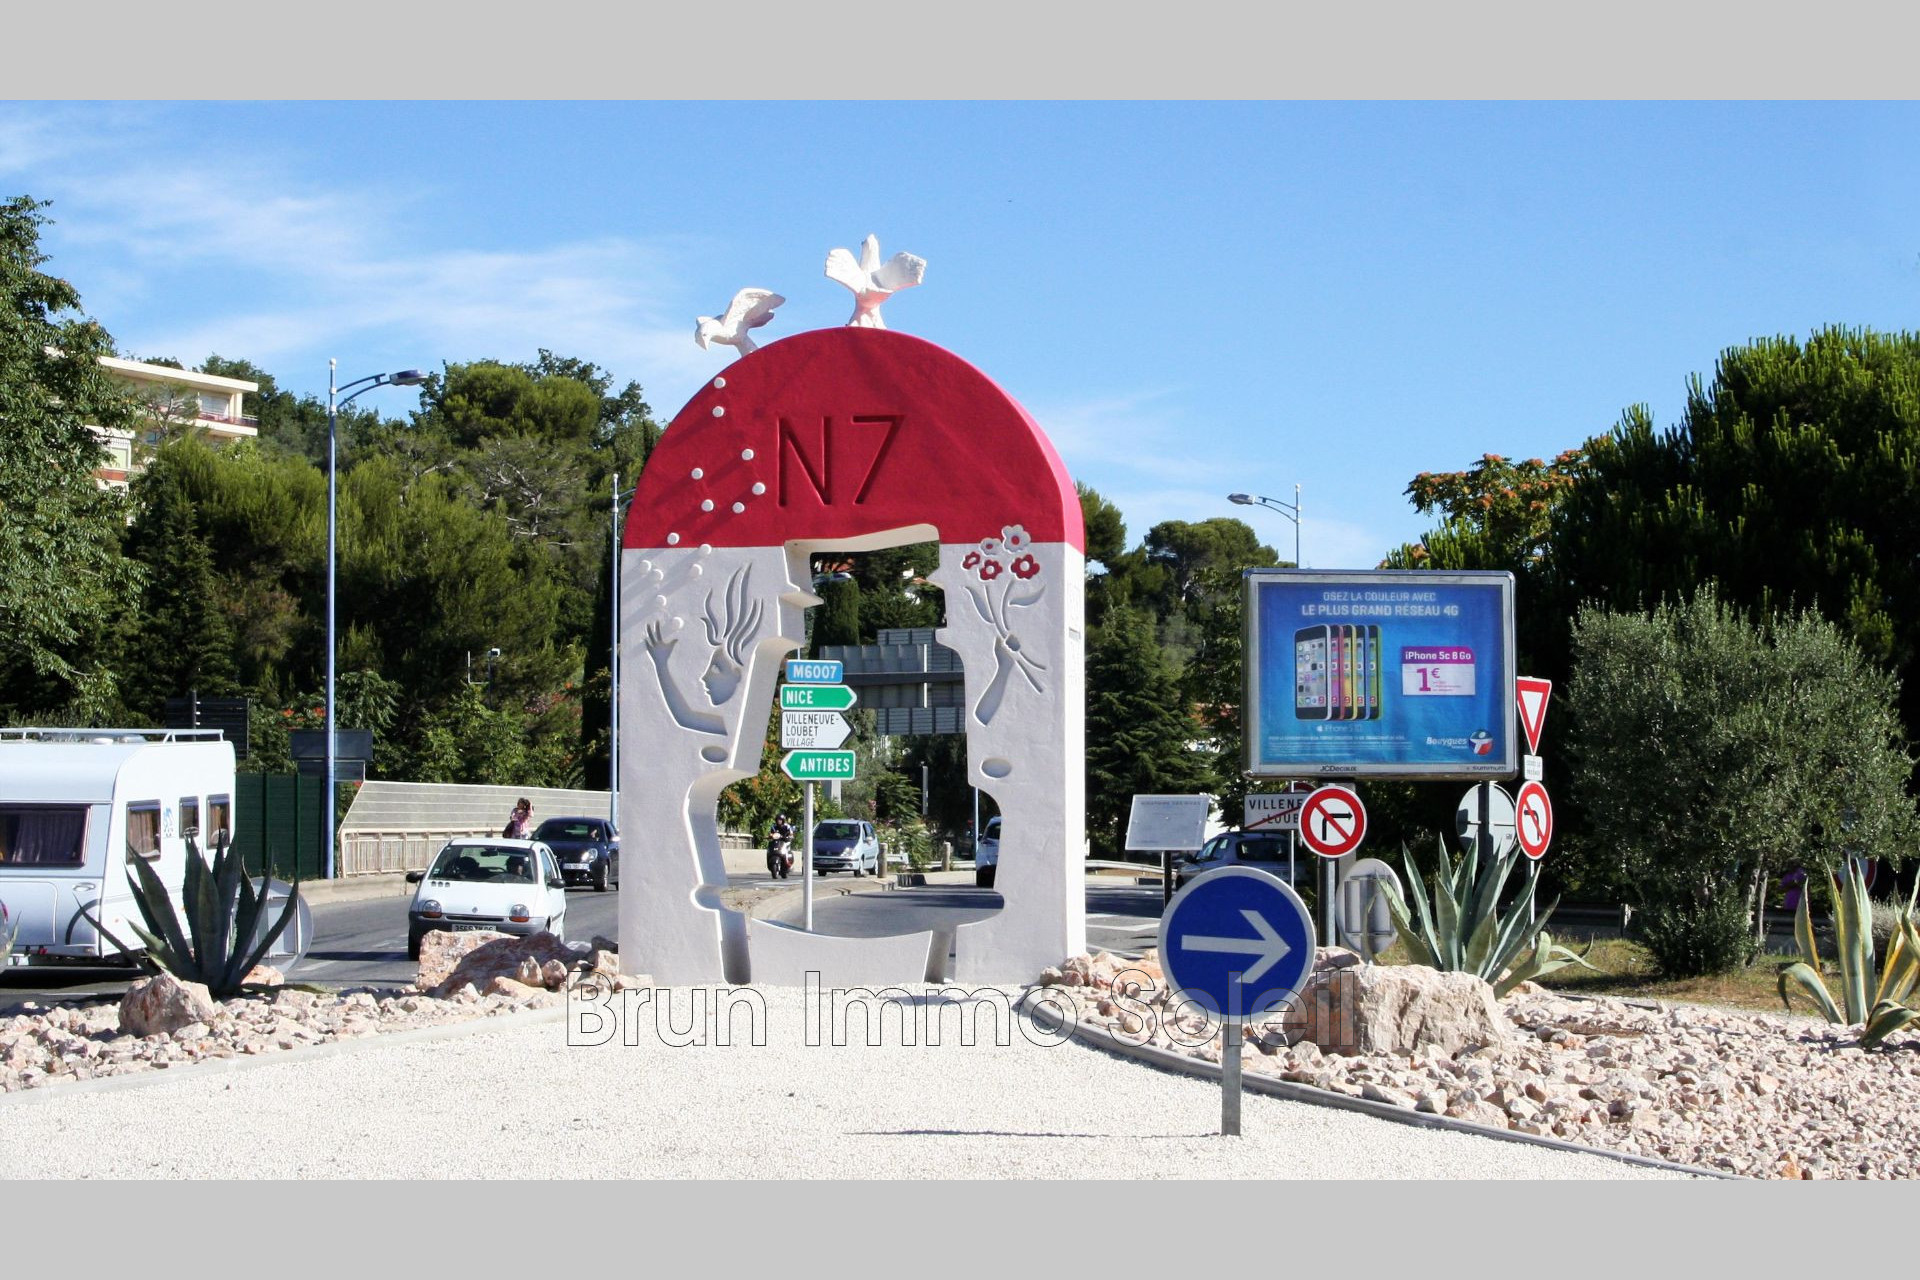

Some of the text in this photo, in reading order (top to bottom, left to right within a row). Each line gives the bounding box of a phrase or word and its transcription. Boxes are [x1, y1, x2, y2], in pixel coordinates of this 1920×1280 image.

[776, 415, 905, 507] N7
[1323, 591, 1437, 602] OSEZ LA COULEUR AVEC
[1301, 602, 1459, 616] LE PLUS GRAND RÉSEAU 4G
[1405, 651, 1437, 660] iPhone
[1439, 651, 1450, 660] 5c
[1459, 651, 1472, 660] Go
[793, 664, 838, 679] M6007
[786, 690, 814, 704] NICE
[786, 713, 839, 725] VILLENEUVE-
[786, 725, 818, 736] LOUBET
[786, 737, 815, 747] VILLAGE
[800, 758, 850, 772] ANTIBES
[1249, 799, 1304, 810] VILLENE
